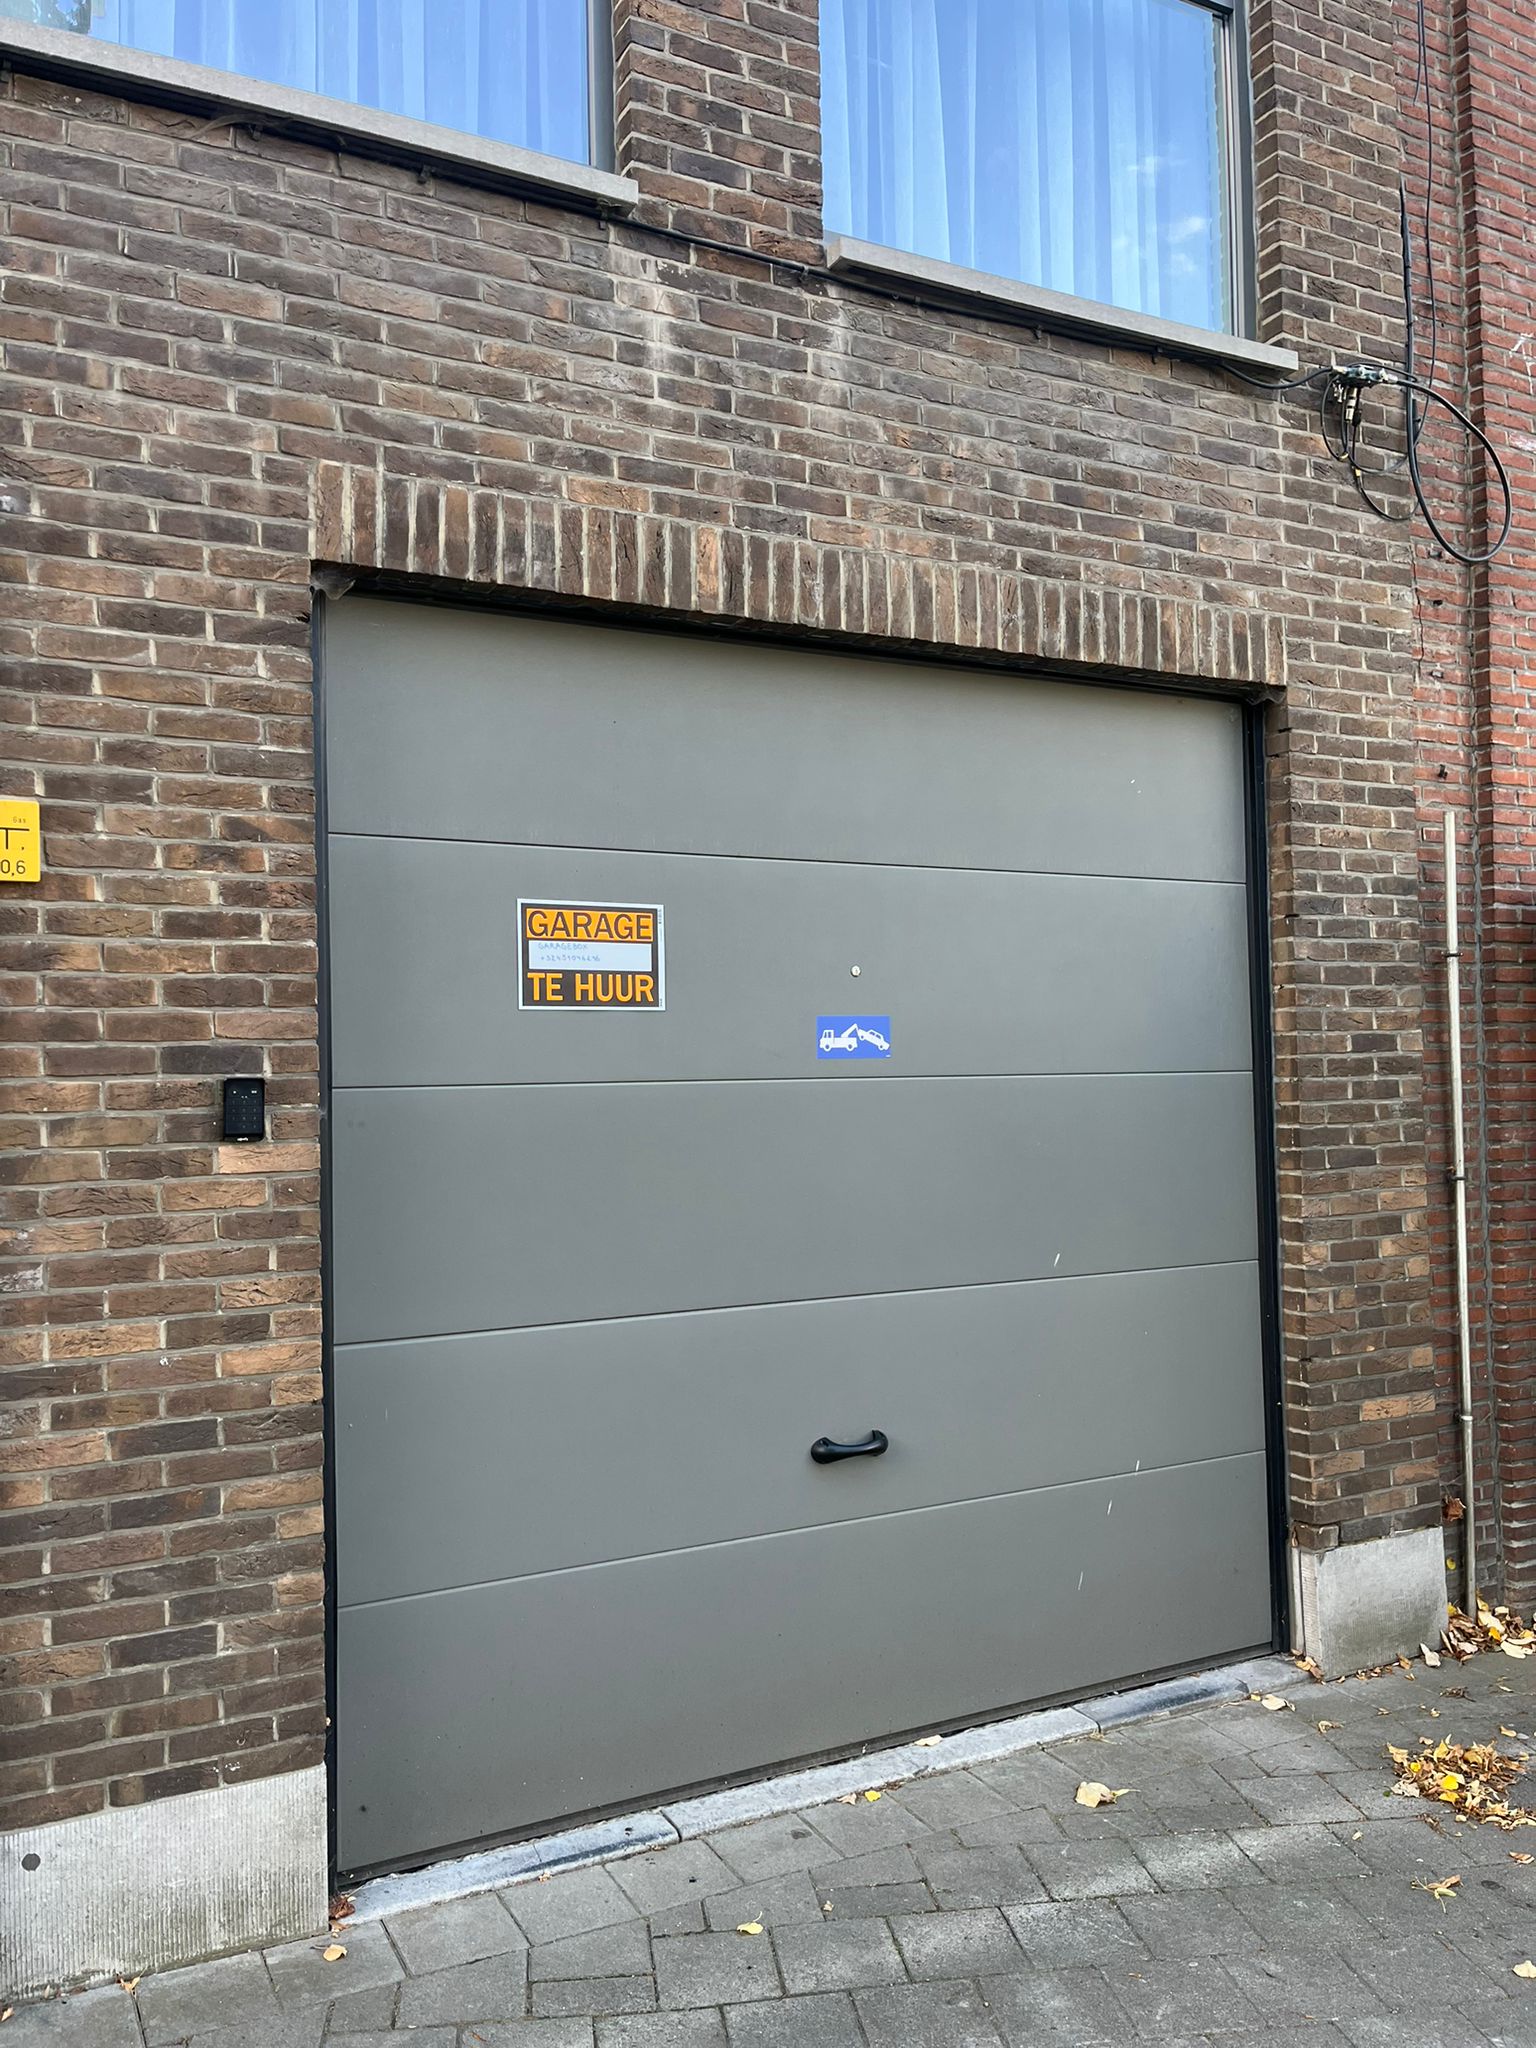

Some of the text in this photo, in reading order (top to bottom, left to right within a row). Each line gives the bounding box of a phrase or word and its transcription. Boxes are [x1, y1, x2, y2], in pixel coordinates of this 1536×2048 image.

[527, 909, 653, 940] GARAGE
[527, 972, 654, 1002] TE HUUR
